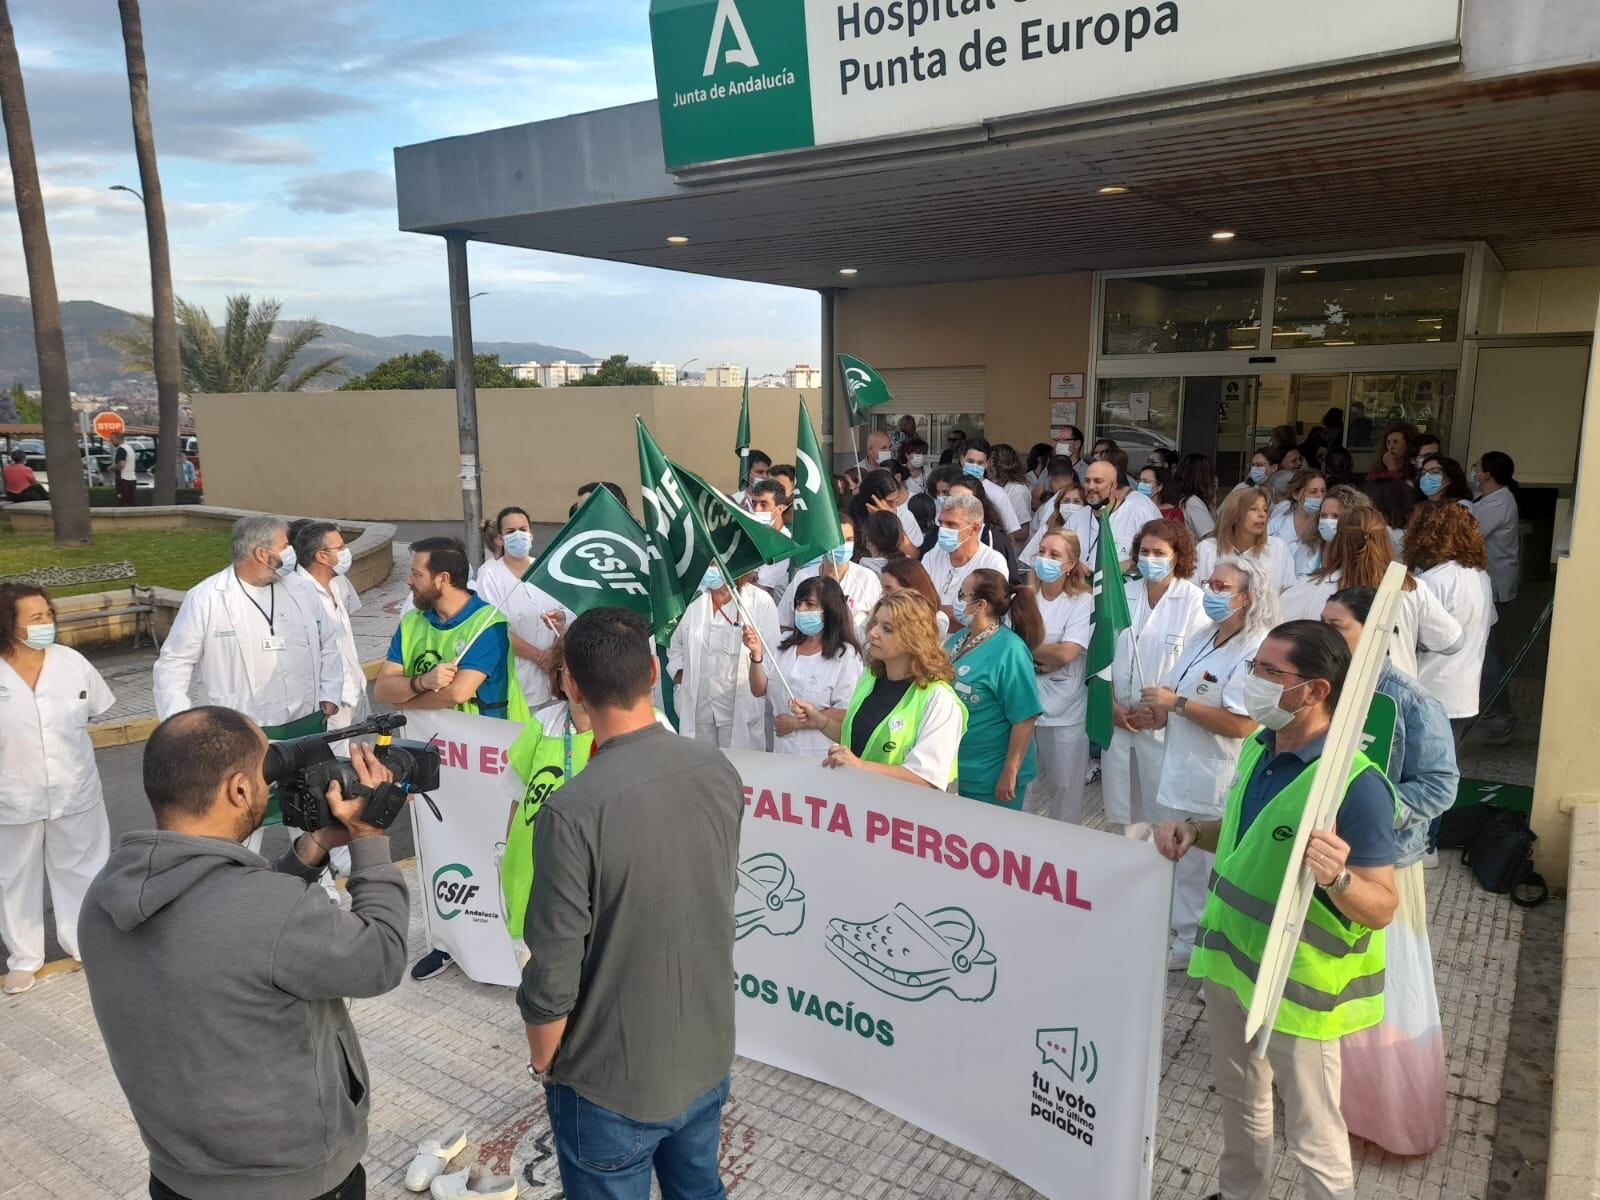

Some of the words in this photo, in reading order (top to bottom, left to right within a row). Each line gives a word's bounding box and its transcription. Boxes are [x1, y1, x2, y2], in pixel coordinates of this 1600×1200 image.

[837, 0, 996, 41] Hospita
[839, 46, 947, 95] Punta
[959, 28, 1007, 72] de
[1021, 1, 1179, 61] Europa
[673, 88, 707, 107] Junta
[709, 83, 726, 99] de
[729, 67, 795, 96] Andalucía
[98, 422, 121, 430] STOP
[575, 542, 650, 595] CSIF
[866, 810, 1092, 911] PERSONAL
[436, 880, 480, 905] CSIF
[734, 971, 779, 1005] OS
[787, 986, 895, 1047] VACÍOS
[1032, 1070, 1050, 1094] tu
[1056, 1086, 1096, 1119] voto
[1032, 1090, 1054, 1108] tiene
[1056, 1102, 1065, 1114] la
[1031, 1102, 1093, 1147] palabra
